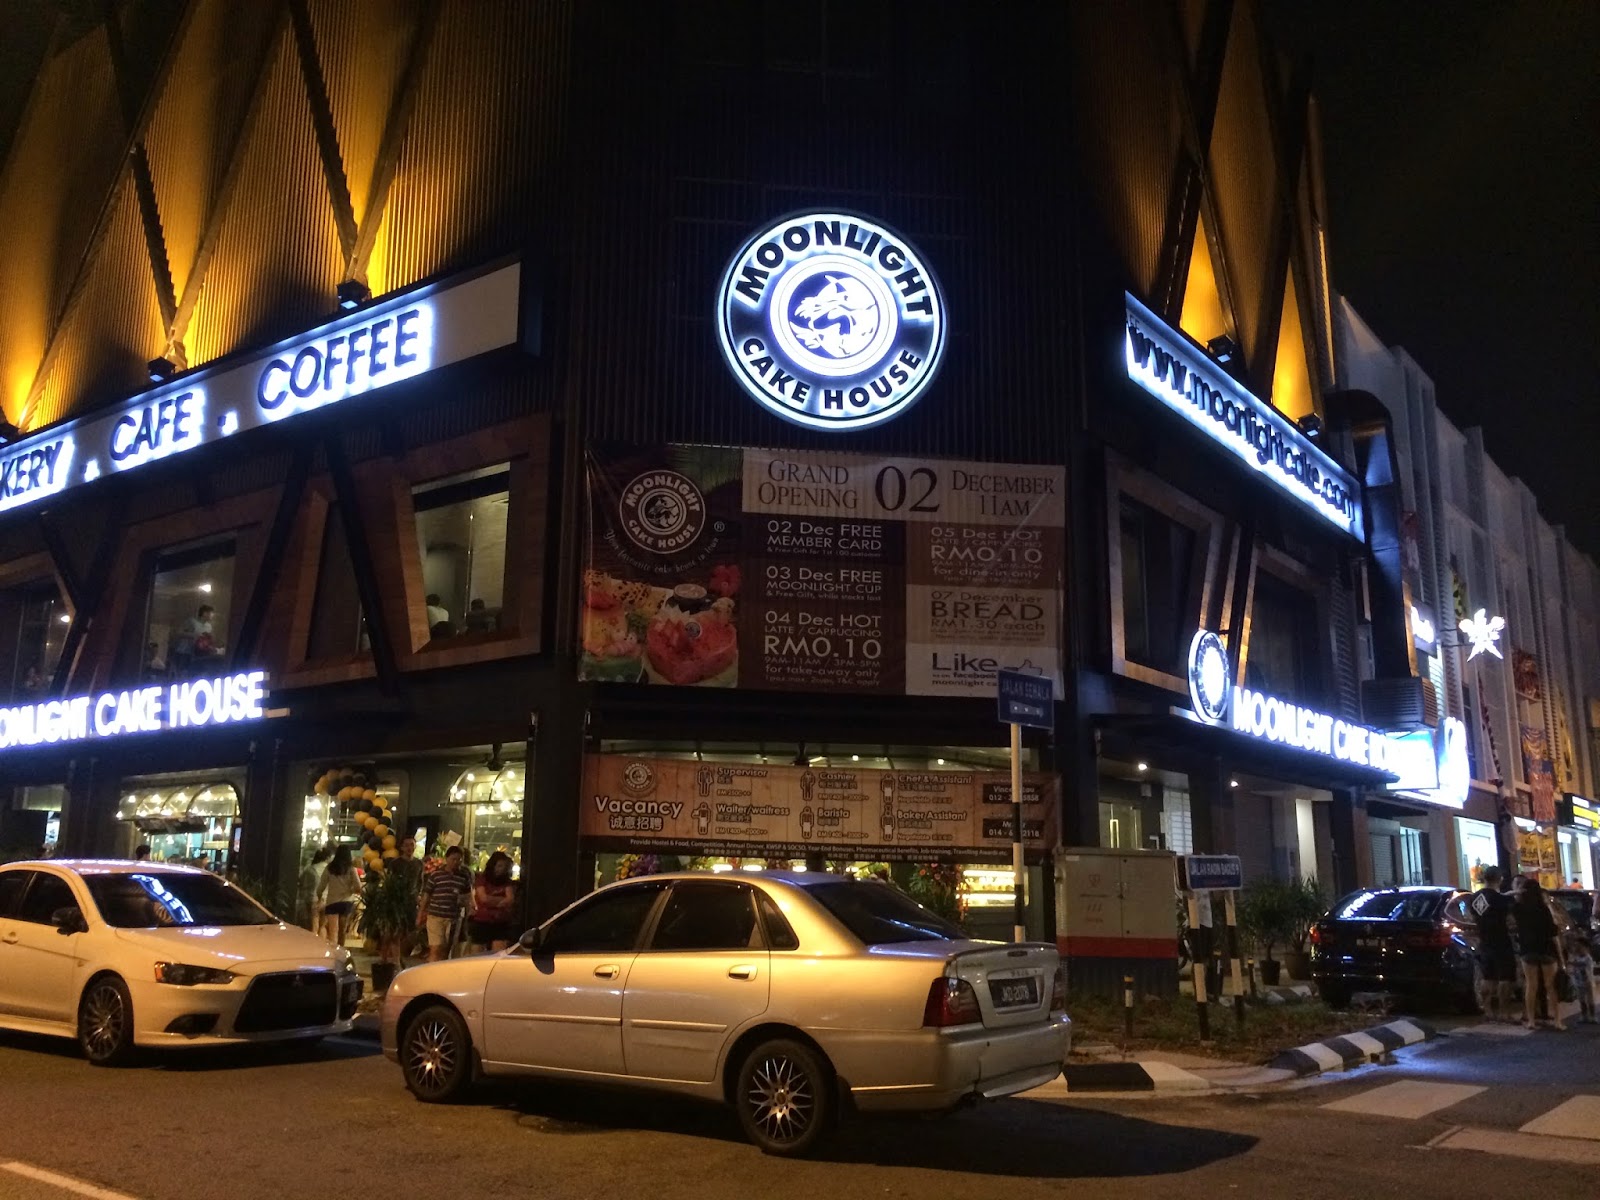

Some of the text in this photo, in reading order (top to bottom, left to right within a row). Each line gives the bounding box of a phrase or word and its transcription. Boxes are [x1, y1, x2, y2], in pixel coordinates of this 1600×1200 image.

[735, 220, 934, 316] MOONLIGHT
[743, 338, 922, 410] CAKE HOUSE
[109, 391, 194, 462] CAFE
[257, 308, 420, 411] COFFEE
[1128, 325, 1356, 522] www.moonlightcake.com
[767, 459, 850, 485] GRAND
[874, 465, 941, 513] 02
[951, 469, 1056, 496] DECEMBER
[625, 474, 701, 512] MOONLIGHT
[757, 481, 859, 509] OPENING
[980, 494, 1031, 516] 11AM
[628, 519, 696, 549] CAKE HOUSE
[767, 519, 883, 538] 02 Dec FREE
[931, 526, 1042, 541] 05 Dec HOT
[766, 534, 882, 551] MEMBER CARD
[930, 544, 1043, 564] RM0.10
[766, 565, 883, 584] 03 Dec FREE
[933, 566, 953, 575] for
[1011, 569, 1041, 580] only
[766, 580, 882, 594] MOONLIGHT CUP
[931, 590, 1044, 604] 07 December
[765, 610, 882, 628] 04 Dec HOT
[930, 600, 1044, 621] BREAD
[764, 625, 795, 635] LATTE
[807, 627, 882, 638] CAPPUCCINO
[930, 618, 1045, 631] RM1.30 each
[763, 634, 882, 660] RM0.10
[765, 664, 880, 678] for take-away only
[932, 652, 998, 672] Like
[932, 679, 984, 688] moonlight
[953, 671, 997, 679] facebook
[94, 686, 162, 737] CAKE
[169, 671, 264, 728] HOUSE
[1232, 685, 1334, 755] MOONLIGHT
[717, 767, 768, 778] Supervisor
[818, 771, 856, 781] Cashier
[898, 774, 974, 785] Chef & Assistant
[594, 795, 684, 819] Vacancy
[716, 803, 791, 817] Waiter/waitress
[817, 807, 851, 819] Barista
[897, 810, 968, 821] Baker Assistant
[609, 815, 664, 831] 诚意招聘
[988, 828, 1003, 836] 014
[629, 838, 651, 846] Provide
